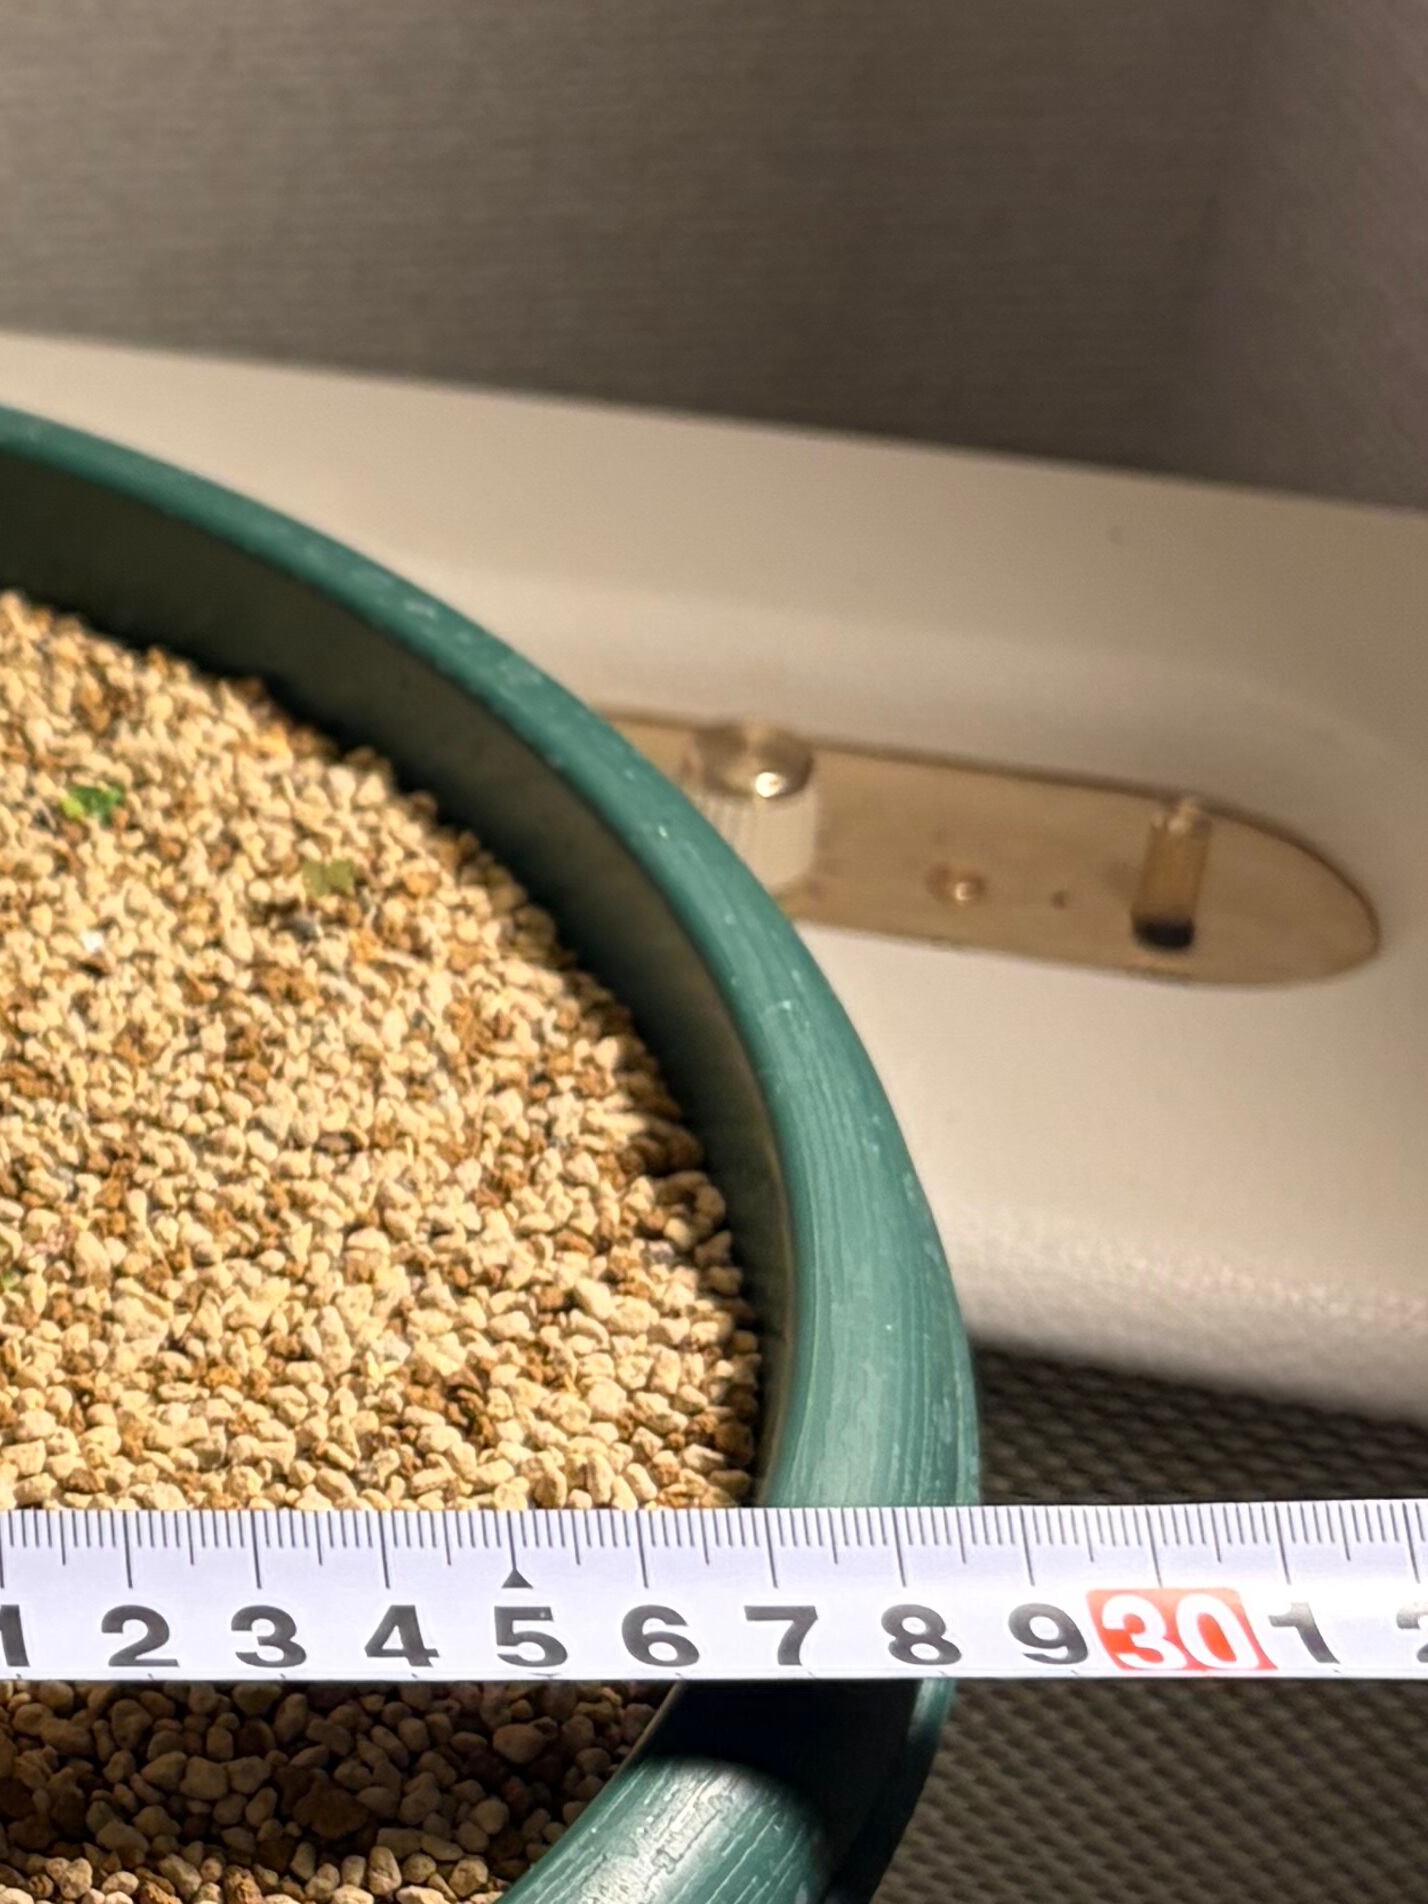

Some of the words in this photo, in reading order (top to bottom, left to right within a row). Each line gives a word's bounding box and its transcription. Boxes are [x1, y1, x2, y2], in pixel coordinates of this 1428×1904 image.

[101, 1604, 180, 1668] 2
[230, 1604, 308, 1669] 3
[364, 1604, 440, 1668] 4
[493, 1605, 569, 1668] 5
[621, 1604, 700, 1668] 6
[743, 1604, 819, 1667] 7
[880, 1603, 963, 1666] 8
[1007, 1602, 1089, 1665] 9
[1100, 1592, 1260, 1671] 30
[1267, 1601, 1341, 1665] 1
